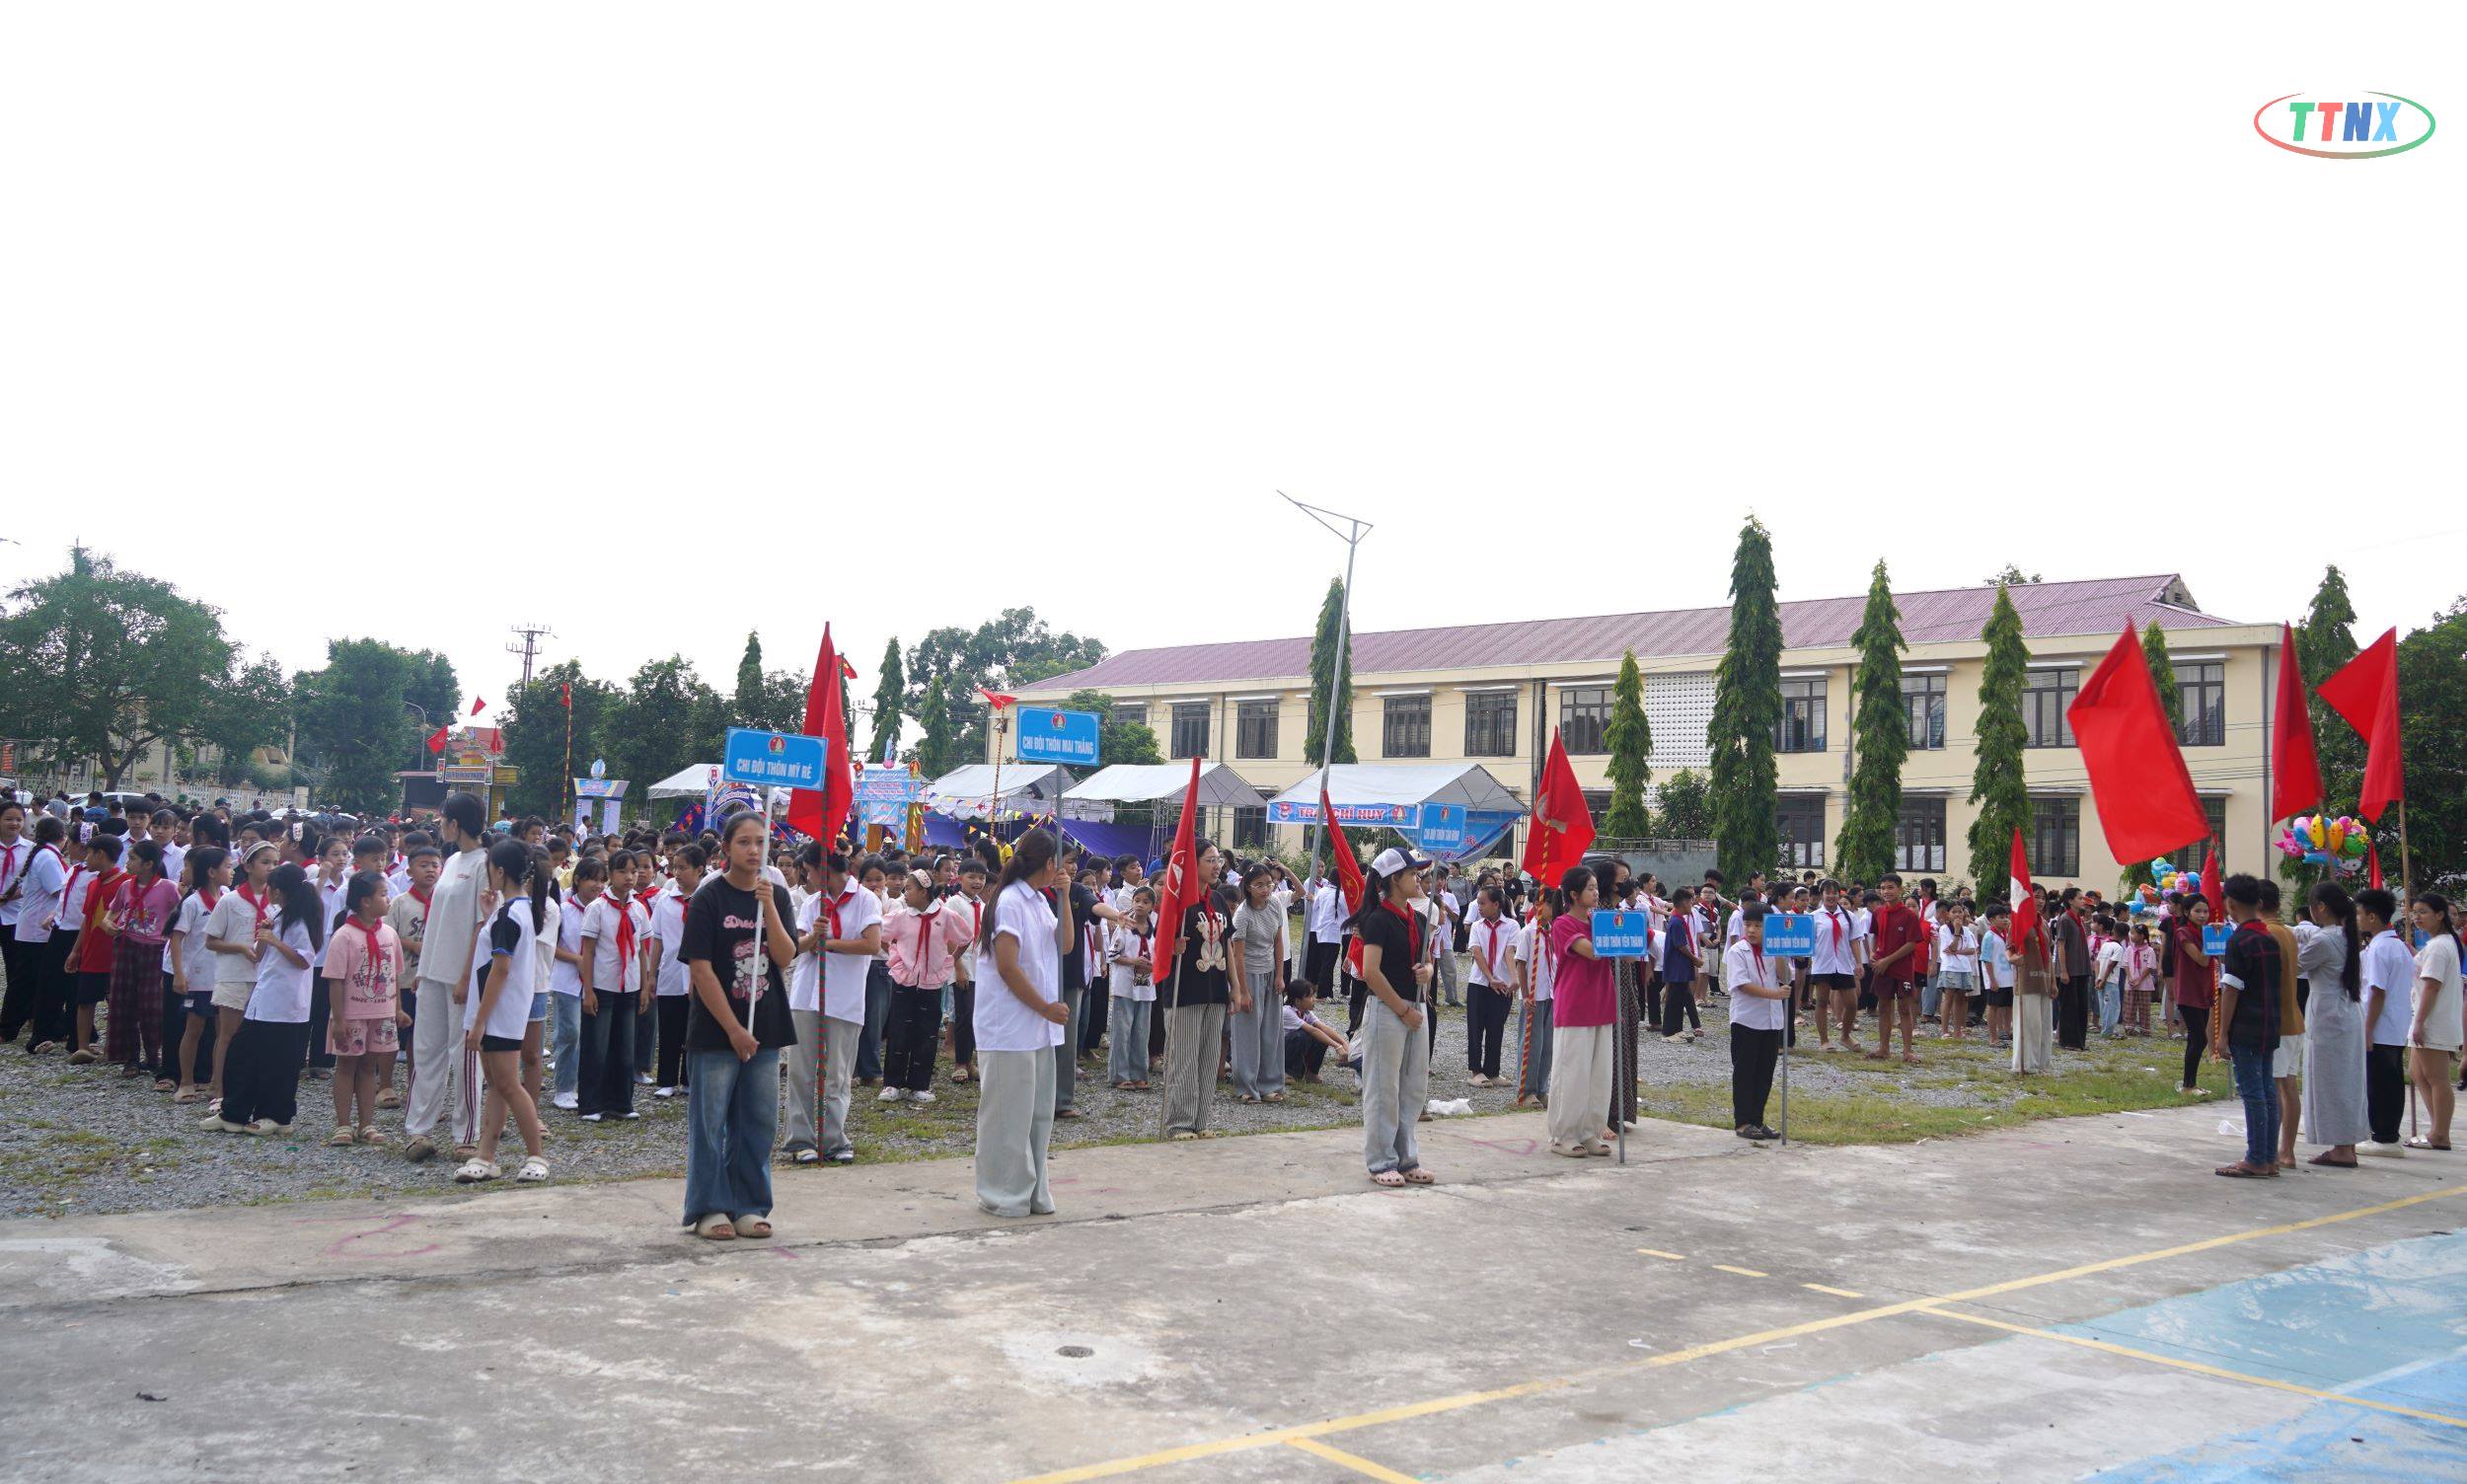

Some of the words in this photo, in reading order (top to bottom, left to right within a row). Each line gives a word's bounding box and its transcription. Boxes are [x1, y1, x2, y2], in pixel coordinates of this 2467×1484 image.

[1022, 736, 1033, 750] CHI
[1034, 735, 1044, 753] ĐỘI
[1045, 736, 1061, 752] THÔN
[1062, 739, 1074, 753] MAI
[736, 758, 750, 773] CHI
[751, 758, 765, 777] ĐỘI
[767, 760, 787, 777] THÔN
[787, 763, 800, 778] MỸ
[1332, 804, 1355, 820] CHỈ
[1357, 809, 1385, 820] HUY
